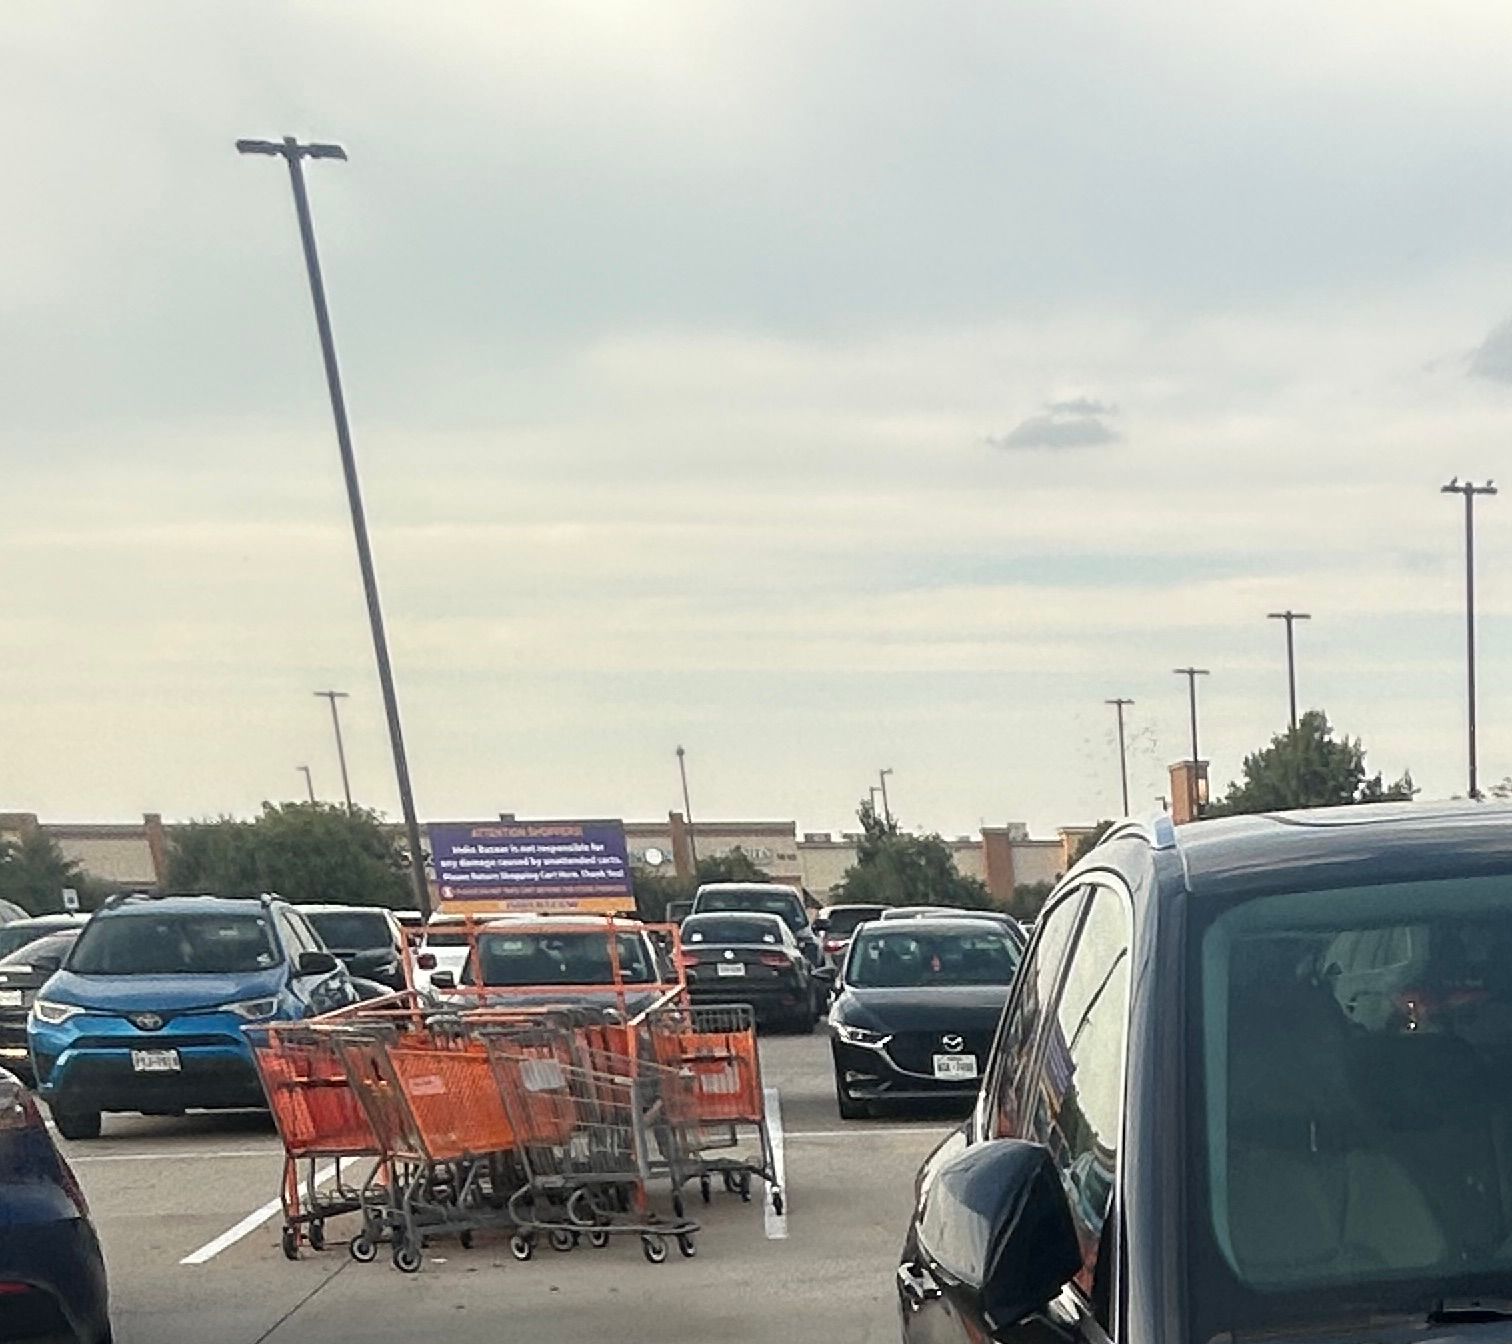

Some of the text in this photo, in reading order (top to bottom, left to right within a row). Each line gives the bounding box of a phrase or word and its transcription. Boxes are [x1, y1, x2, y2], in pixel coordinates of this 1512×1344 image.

[537, 842, 590, 854] responsible
[459, 858, 495, 868] damage
[496, 857, 529, 866] caused
[543, 856, 596, 866] unattended
